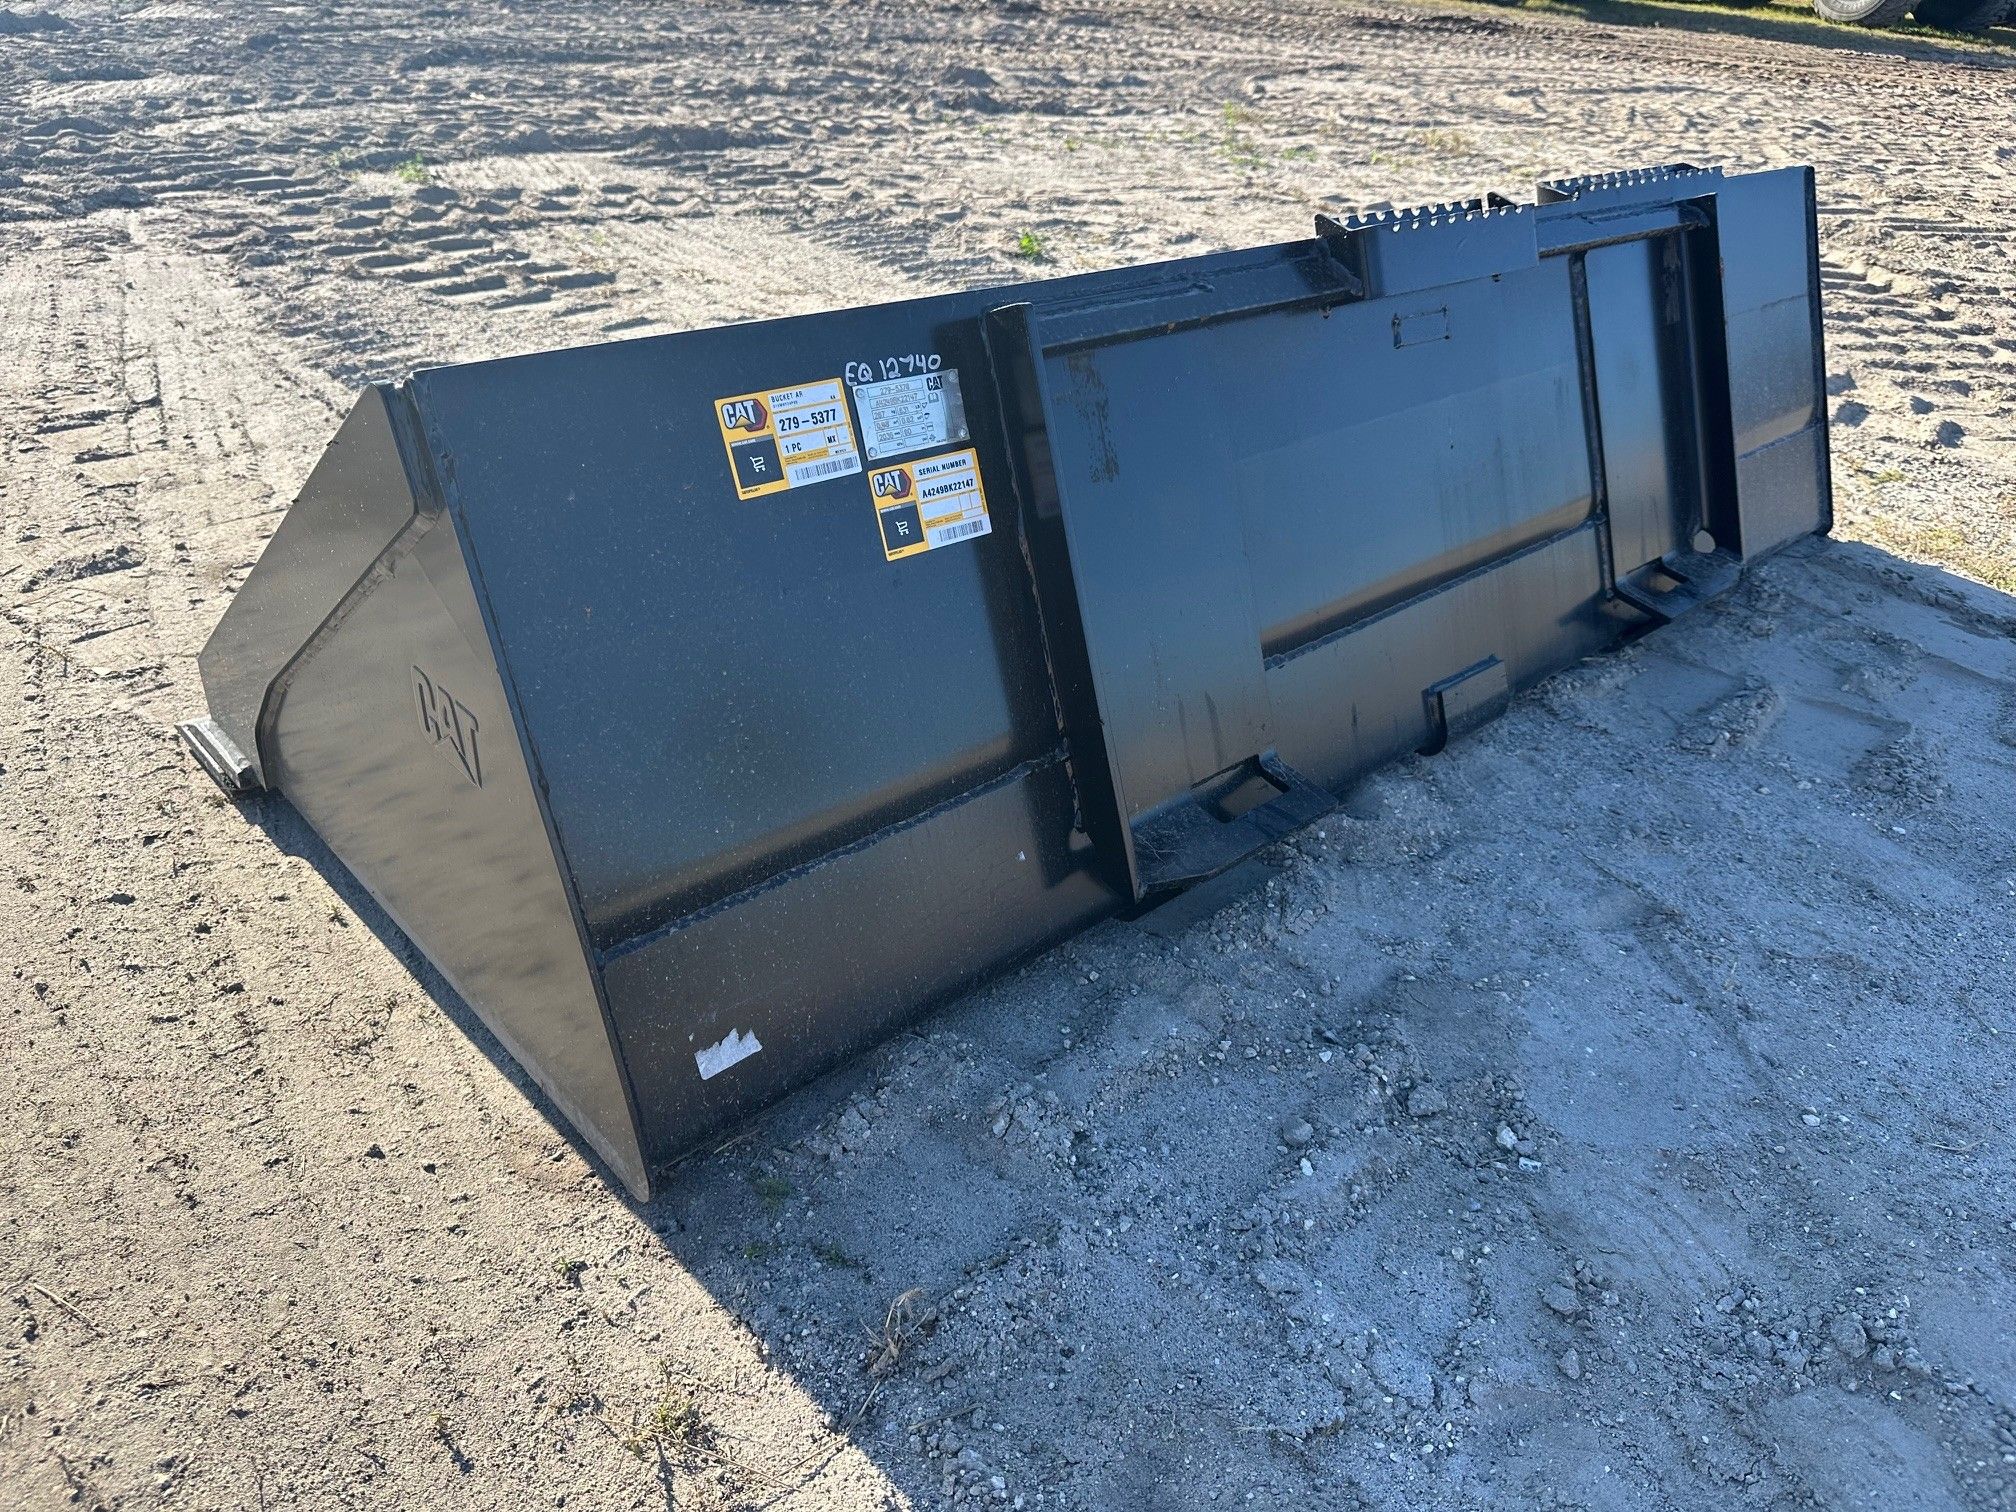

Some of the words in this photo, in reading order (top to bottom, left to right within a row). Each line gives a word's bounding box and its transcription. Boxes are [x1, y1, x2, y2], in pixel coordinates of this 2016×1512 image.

[845, 361, 873, 387] EQ
[879, 354, 941, 380] 12740
[926, 375, 943, 391] CAT
[771, 392, 793, 403] BUCKET
[722, 400, 756, 429] CAT
[779, 409, 836, 431] 279-5377
[785, 444, 790, 453] 1
[792, 442, 802, 452] PC
[827, 435, 836, 443] MX
[919, 466, 940, 475] SERIAL
[942, 459, 966, 470] NUMBER
[874, 471, 901, 497] CAT
[923, 479, 973, 498] A4249BK22147
[410, 664, 482, 790] CAT
